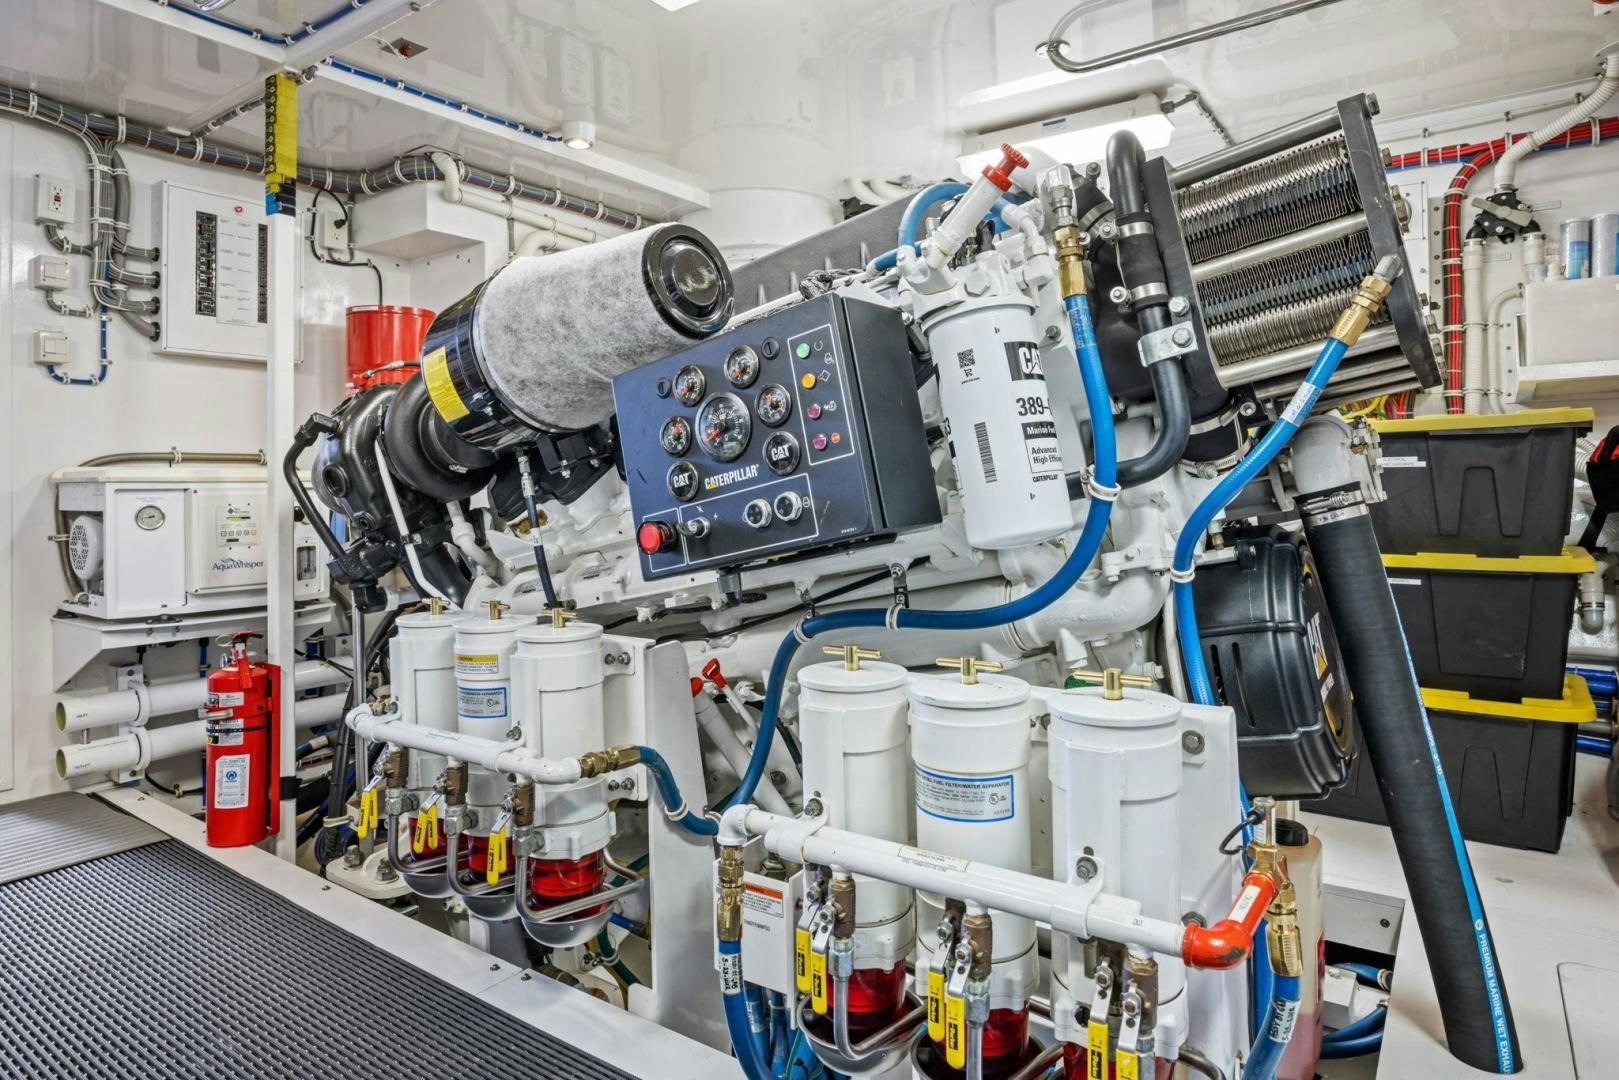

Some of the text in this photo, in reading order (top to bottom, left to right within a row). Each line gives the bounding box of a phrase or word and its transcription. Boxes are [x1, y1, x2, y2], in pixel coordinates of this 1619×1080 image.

[1018, 347, 1043, 375] CA
[771, 444, 791, 461] CAT
[1032, 455, 1048, 465] High
[672, 472, 691, 488] CAT
[704, 465, 759, 489] CATERPILLAR
[212, 559, 264, 572] AquaWhisper
[1478, 933, 1494, 977] PREMIUM
[1488, 978, 1503, 1016] MARINE
[1496, 1016, 1507, 1039] WET
